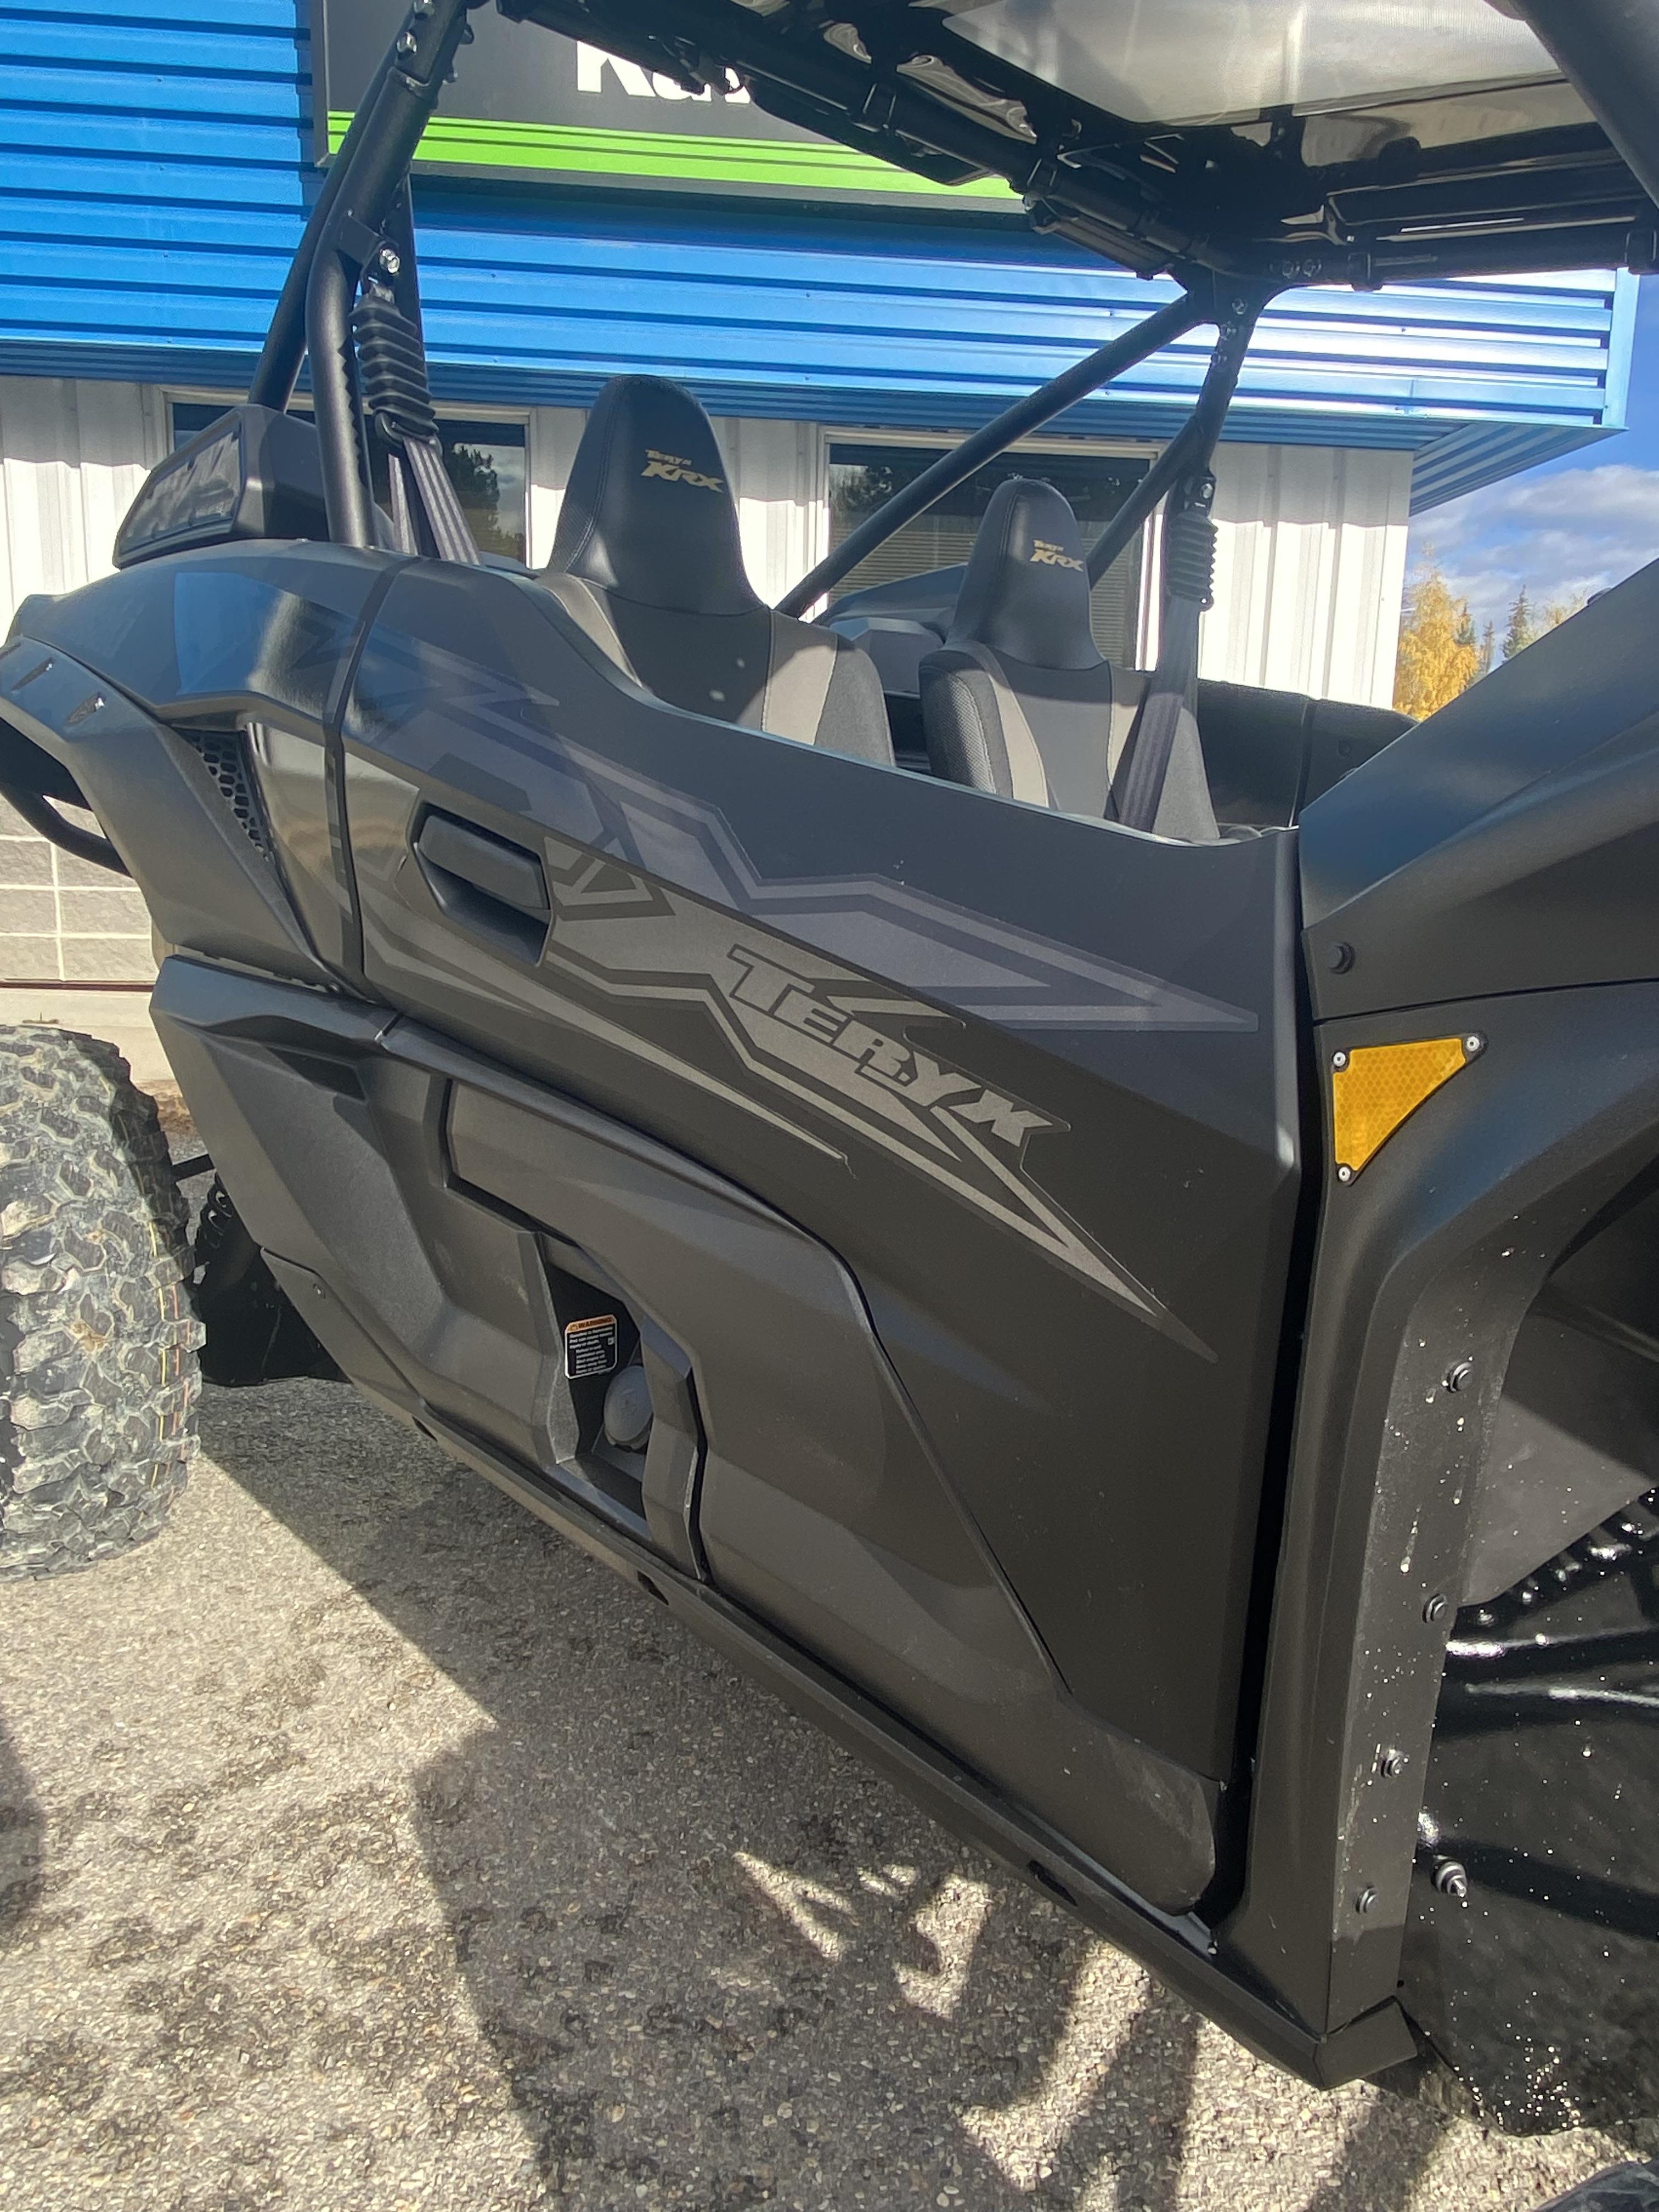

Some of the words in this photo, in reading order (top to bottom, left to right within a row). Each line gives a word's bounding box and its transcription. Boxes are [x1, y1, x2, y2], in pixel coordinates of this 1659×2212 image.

[641, 461, 724, 493] KRX
[1030, 549, 1084, 572] KRX
[727, 944, 1053, 1147] TERYX
